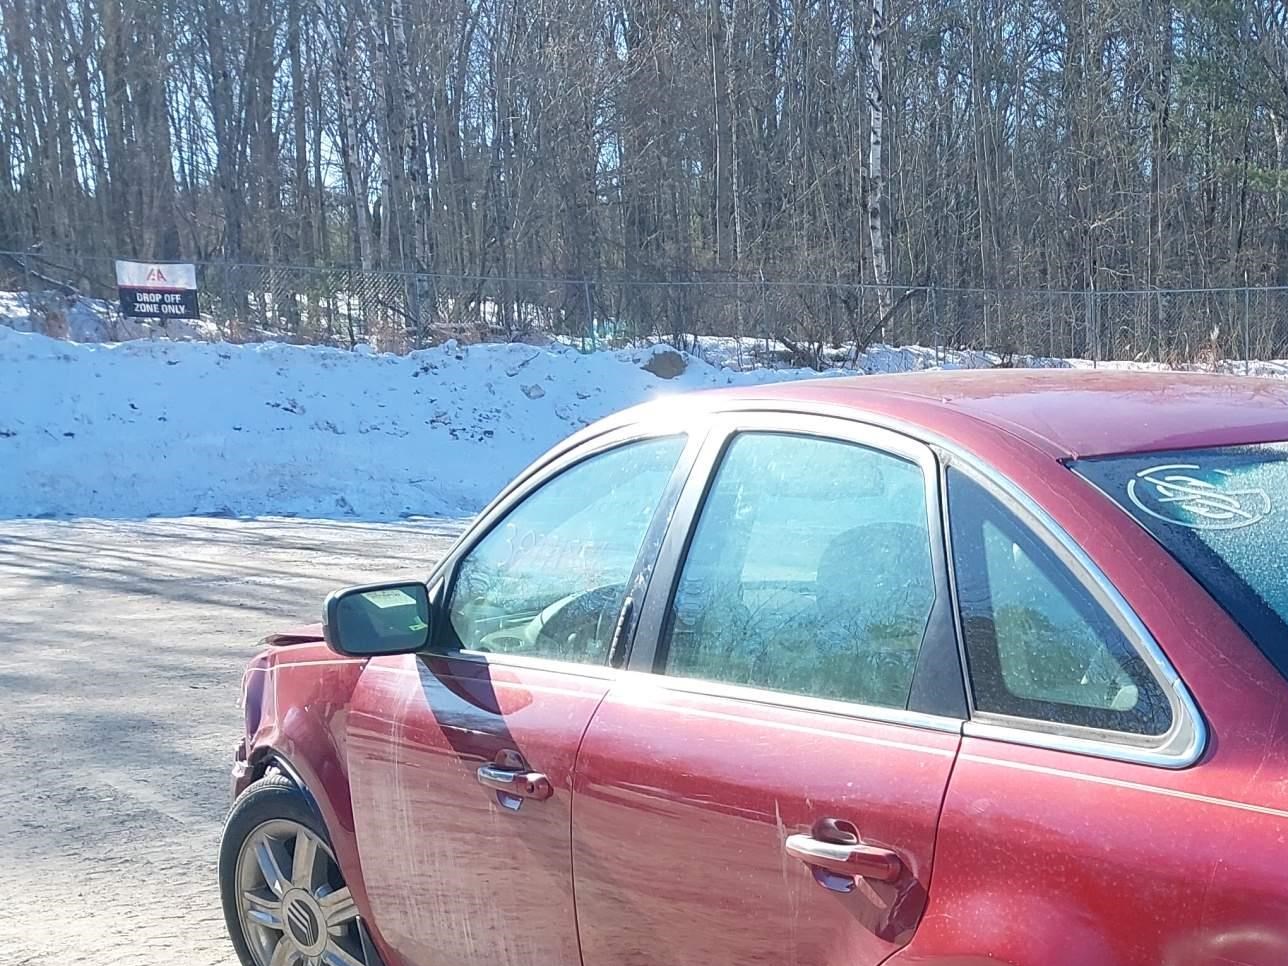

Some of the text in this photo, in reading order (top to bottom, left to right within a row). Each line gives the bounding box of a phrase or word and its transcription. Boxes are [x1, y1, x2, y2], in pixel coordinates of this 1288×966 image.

[136, 293, 181, 303] DROP OFF
[134, 303, 185, 314] ZONE ONLY
